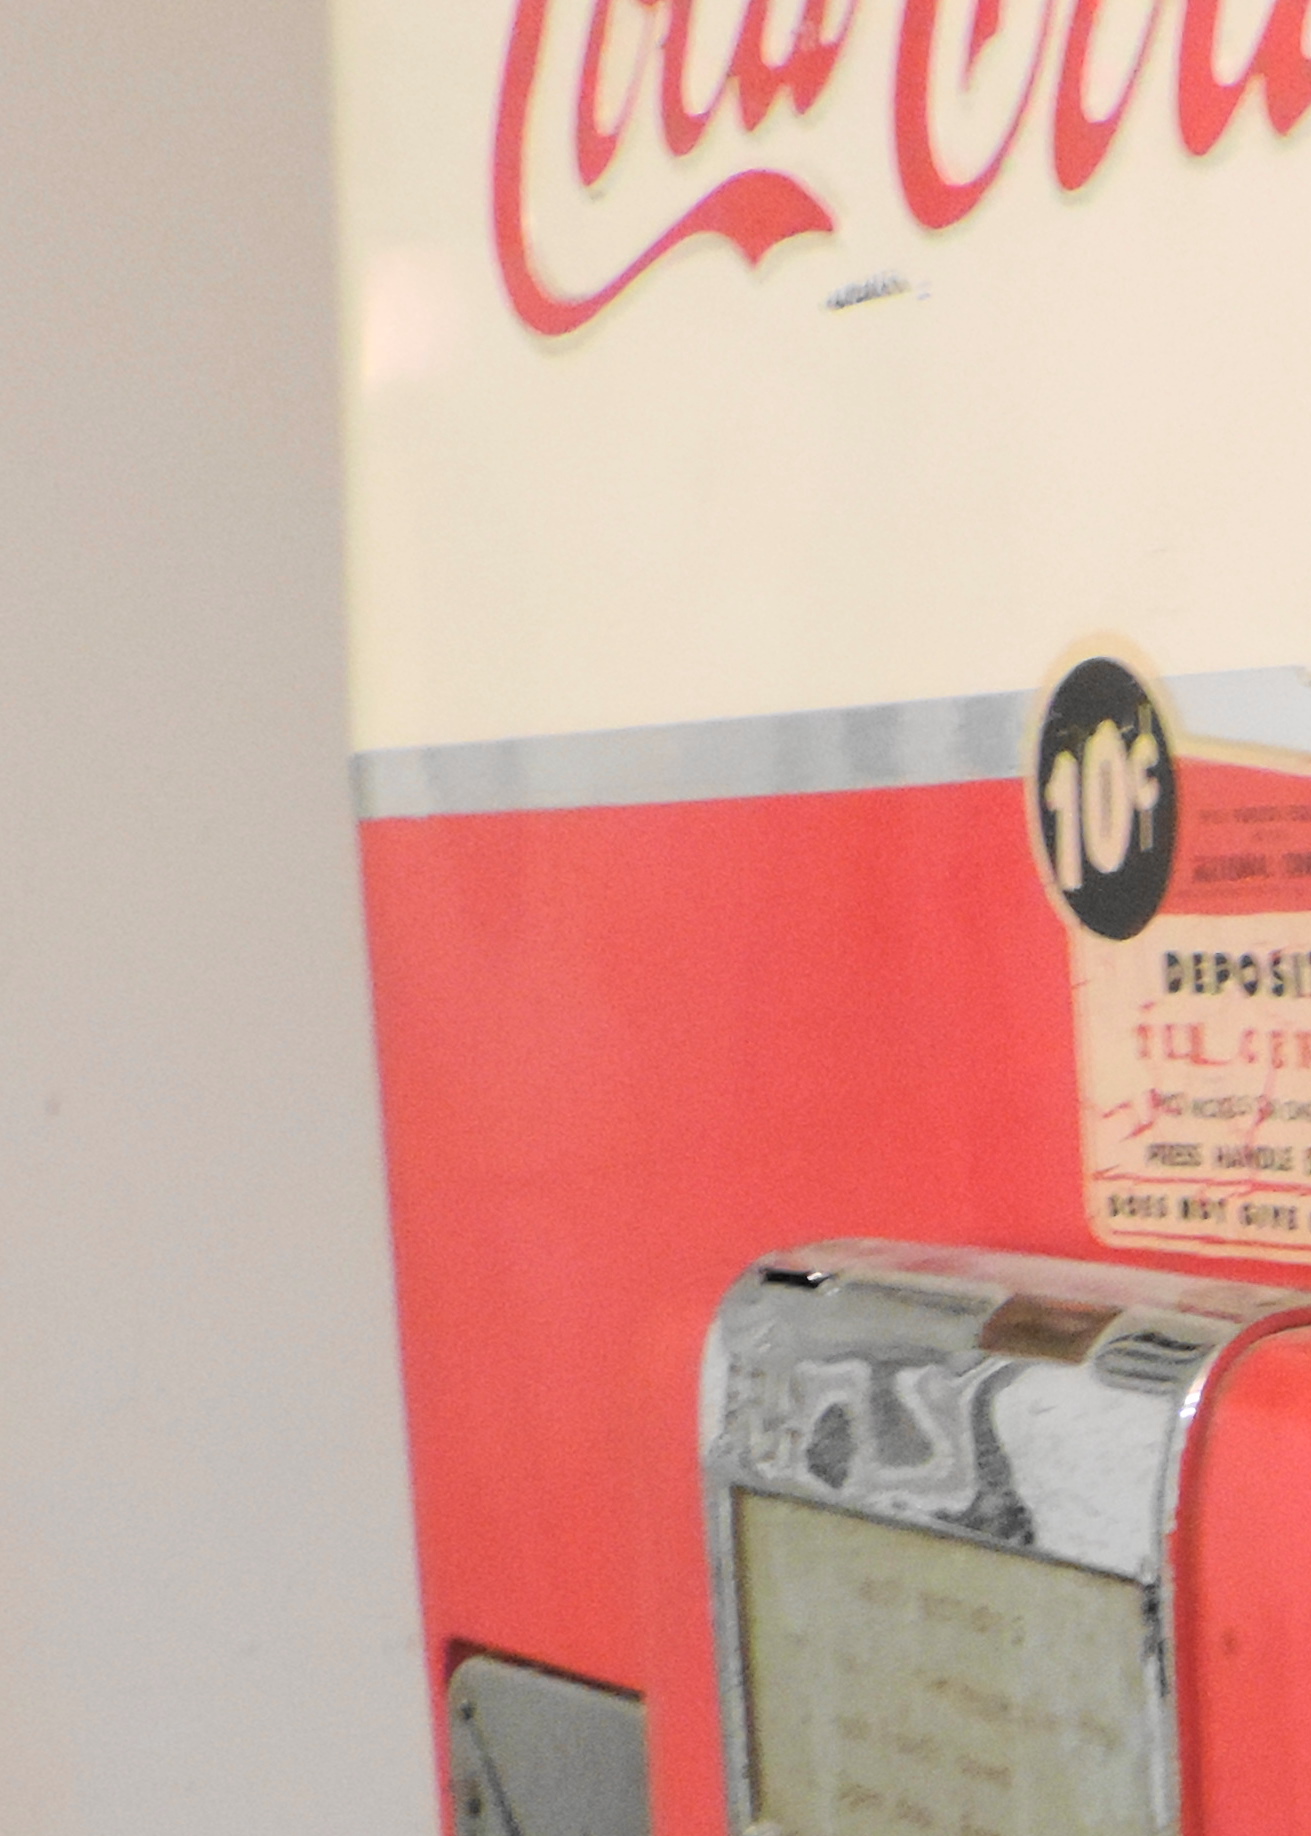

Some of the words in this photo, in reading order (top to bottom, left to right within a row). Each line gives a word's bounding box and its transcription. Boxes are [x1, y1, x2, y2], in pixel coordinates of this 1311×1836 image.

[1044, 703, 1160, 891] 10¢
[1108, 1195, 1169, 1219] DOES
[1181, 1198, 1228, 1223] NOT
[1239, 1202, 1298, 1231] GIVE
